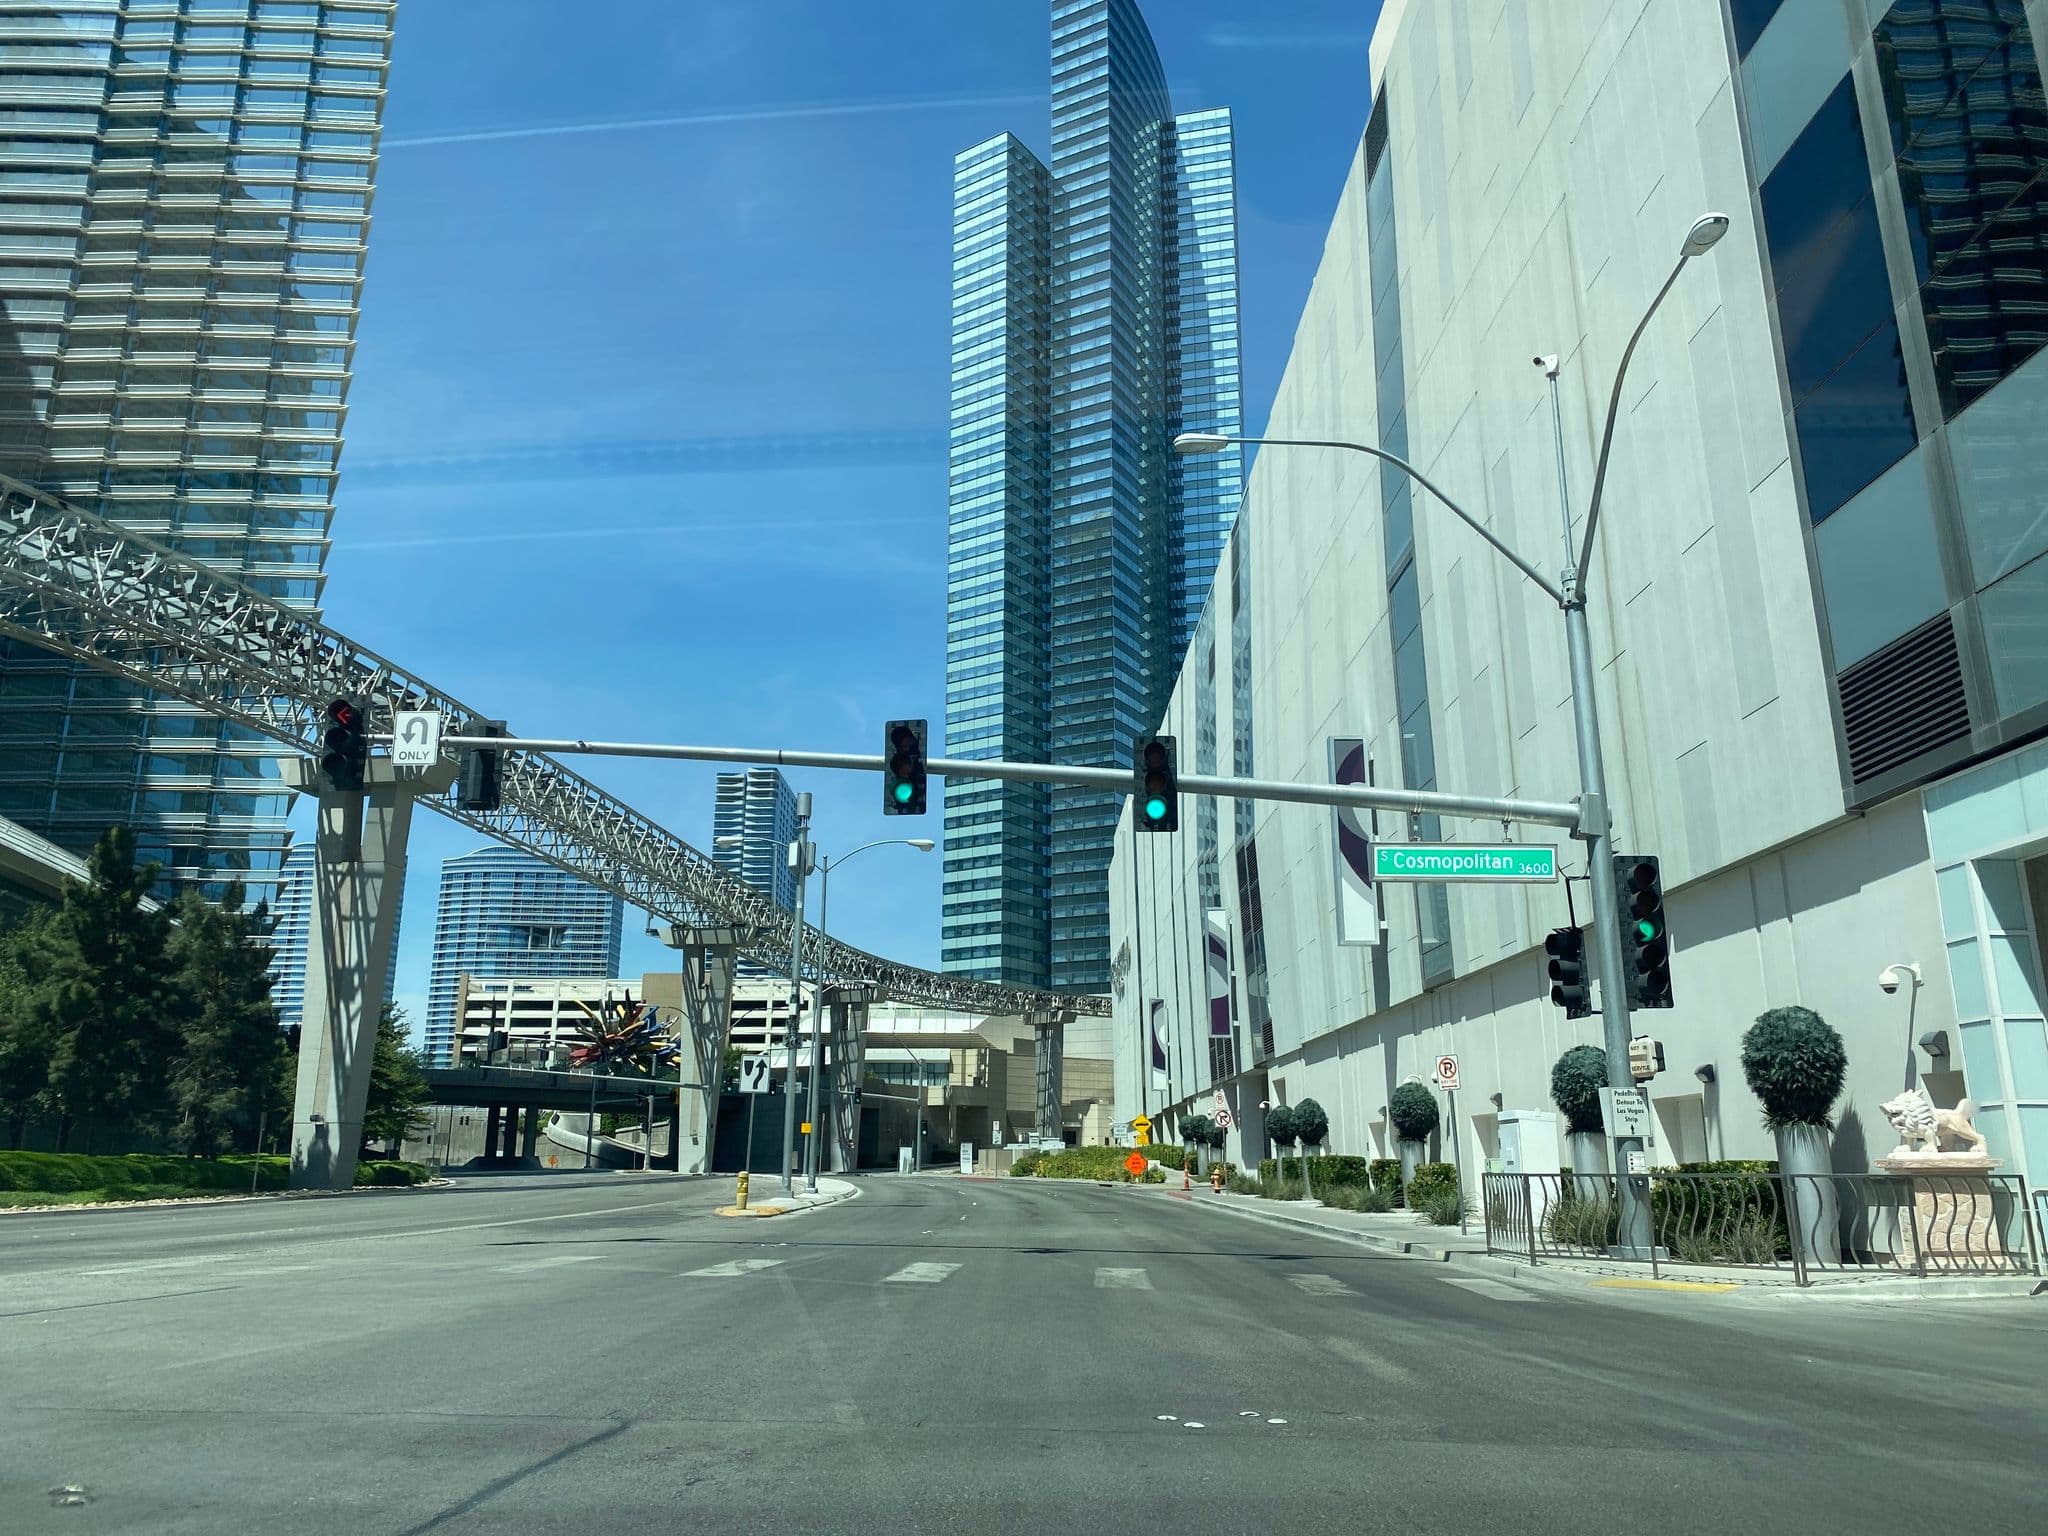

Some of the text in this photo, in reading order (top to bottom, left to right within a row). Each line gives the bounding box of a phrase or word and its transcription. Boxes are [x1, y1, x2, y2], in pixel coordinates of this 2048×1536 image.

[399, 751, 430, 760] ONLY
[1381, 851, 1549, 874] S Cosmopolitan 3600
